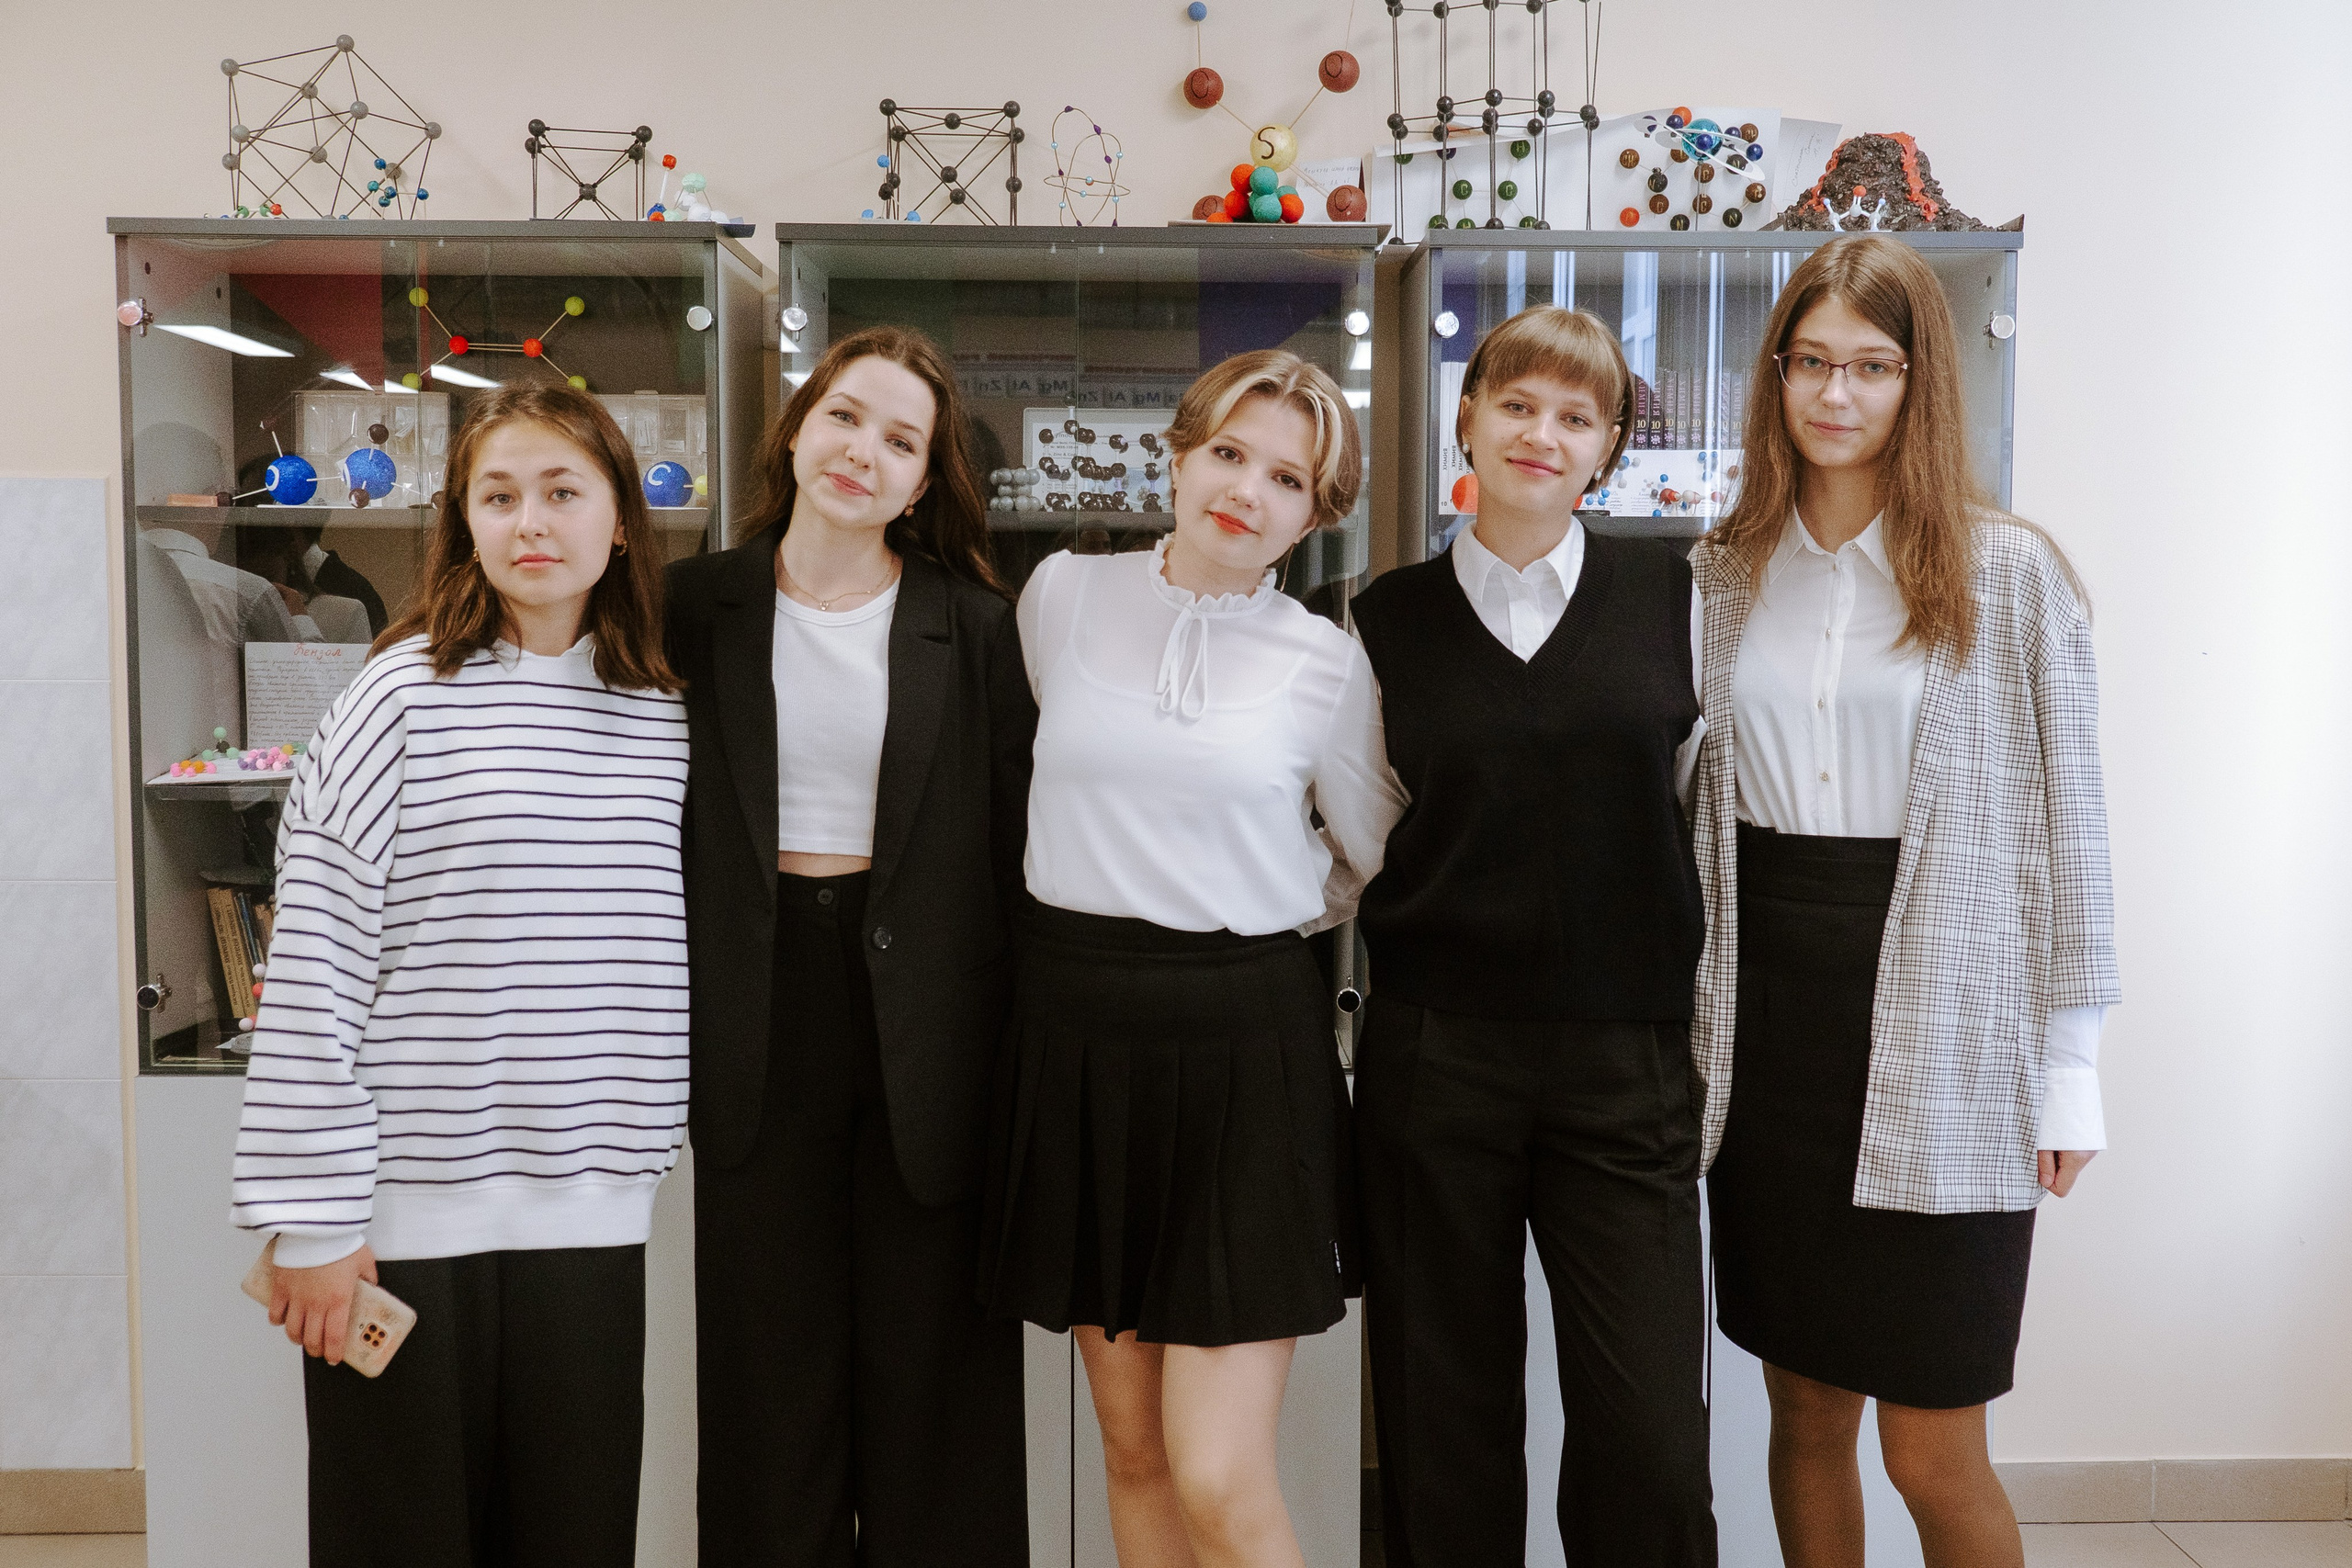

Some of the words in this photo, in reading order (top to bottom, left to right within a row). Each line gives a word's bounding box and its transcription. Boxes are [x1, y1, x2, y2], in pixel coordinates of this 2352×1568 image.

[1258, 126, 1275, 160] S
[1637, 420, 1646, 429] 10
[1651, 421, 1661, 430] 10
[1665, 419, 1674, 427] 10
[1678, 422, 1687, 430] 10
[1692, 419, 1702, 428] 10
[648, 464, 671, 486] C
[293, 642, 342, 660] Бензол
